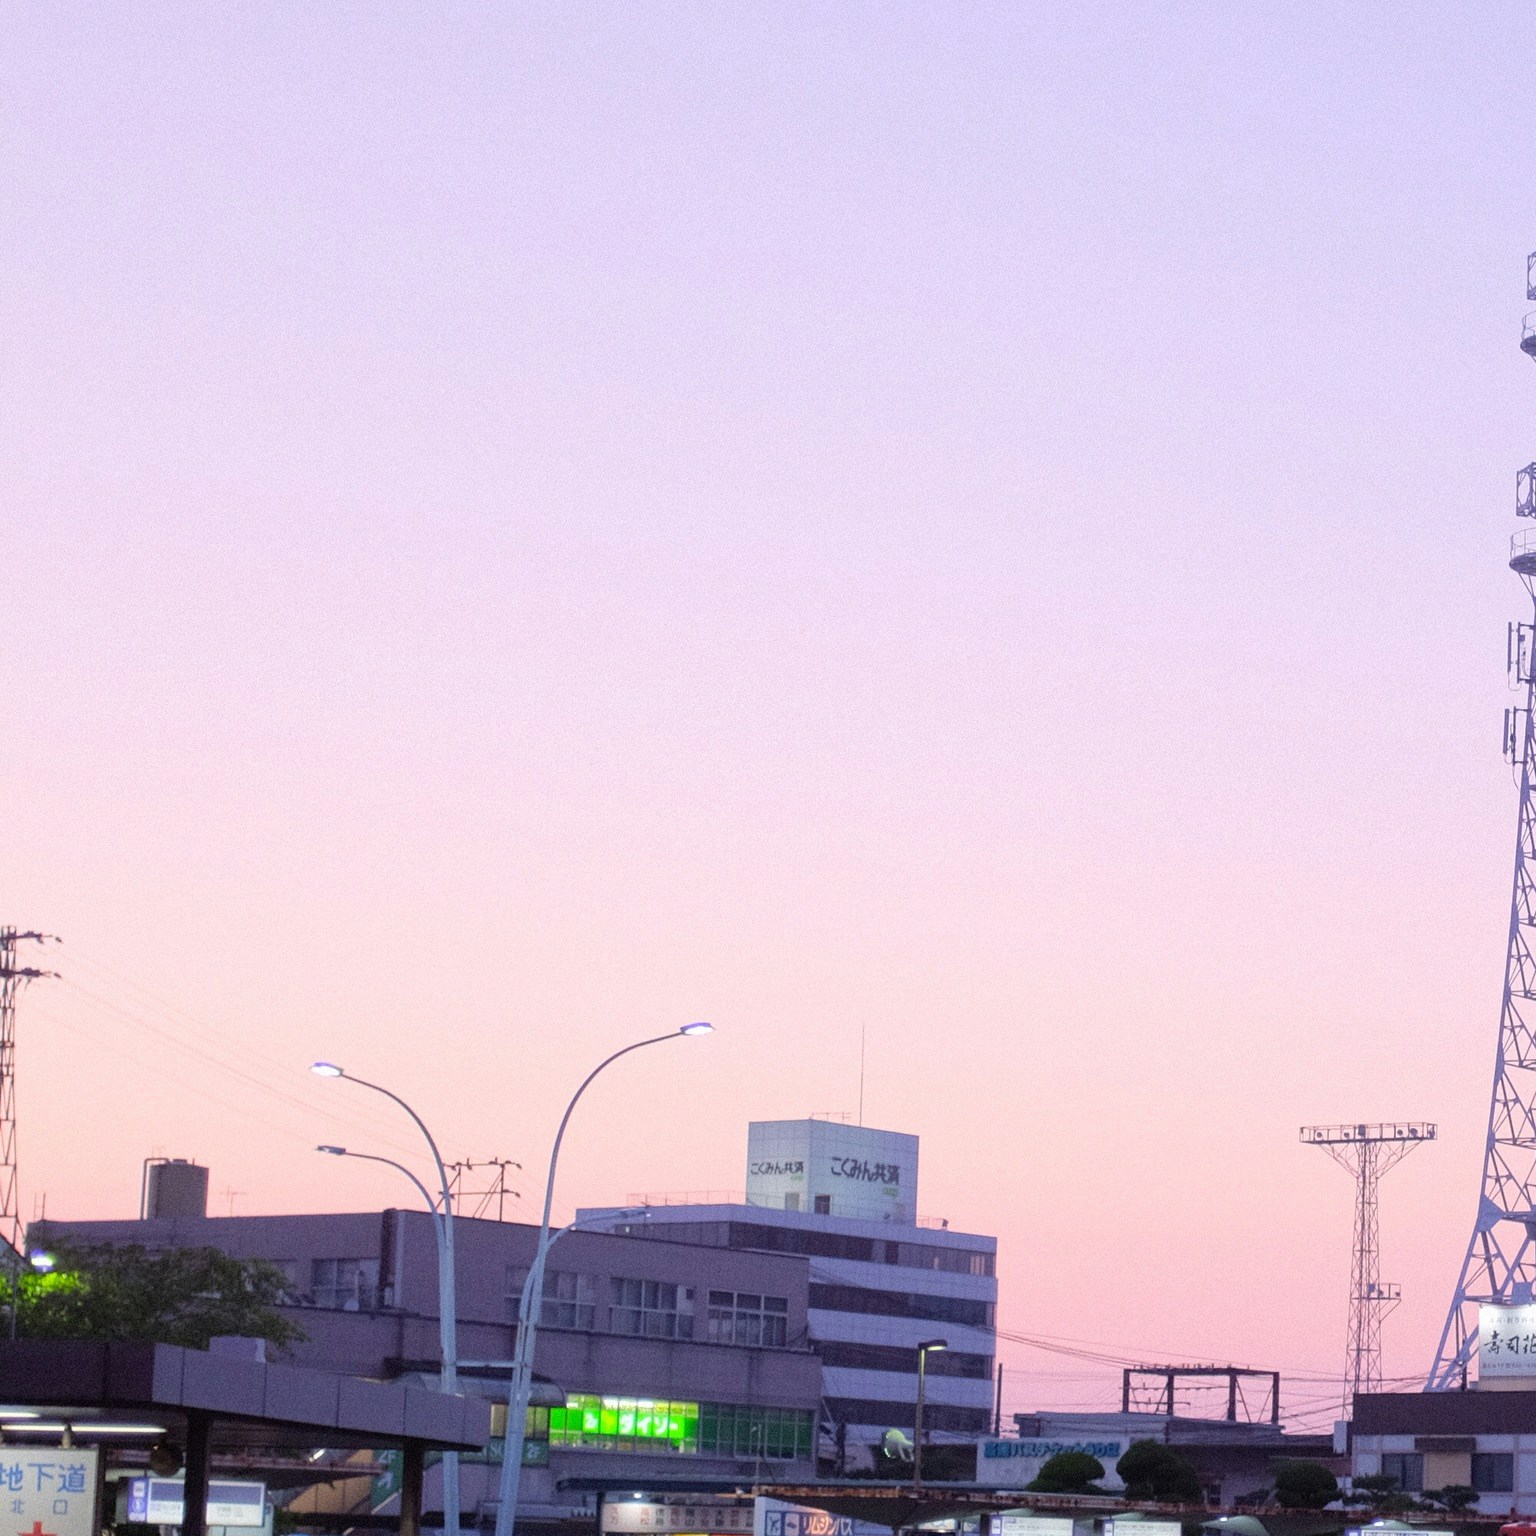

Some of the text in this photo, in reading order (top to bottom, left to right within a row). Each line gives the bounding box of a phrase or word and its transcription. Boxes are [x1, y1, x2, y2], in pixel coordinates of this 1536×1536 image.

[751, 1161, 804, 1176] こくみん共済
[830, 1156, 901, 1185] こくみん共済
[0, 1463, 86, 1493] 地下道
[802, 1515, 853, 1536] リムジンバス
